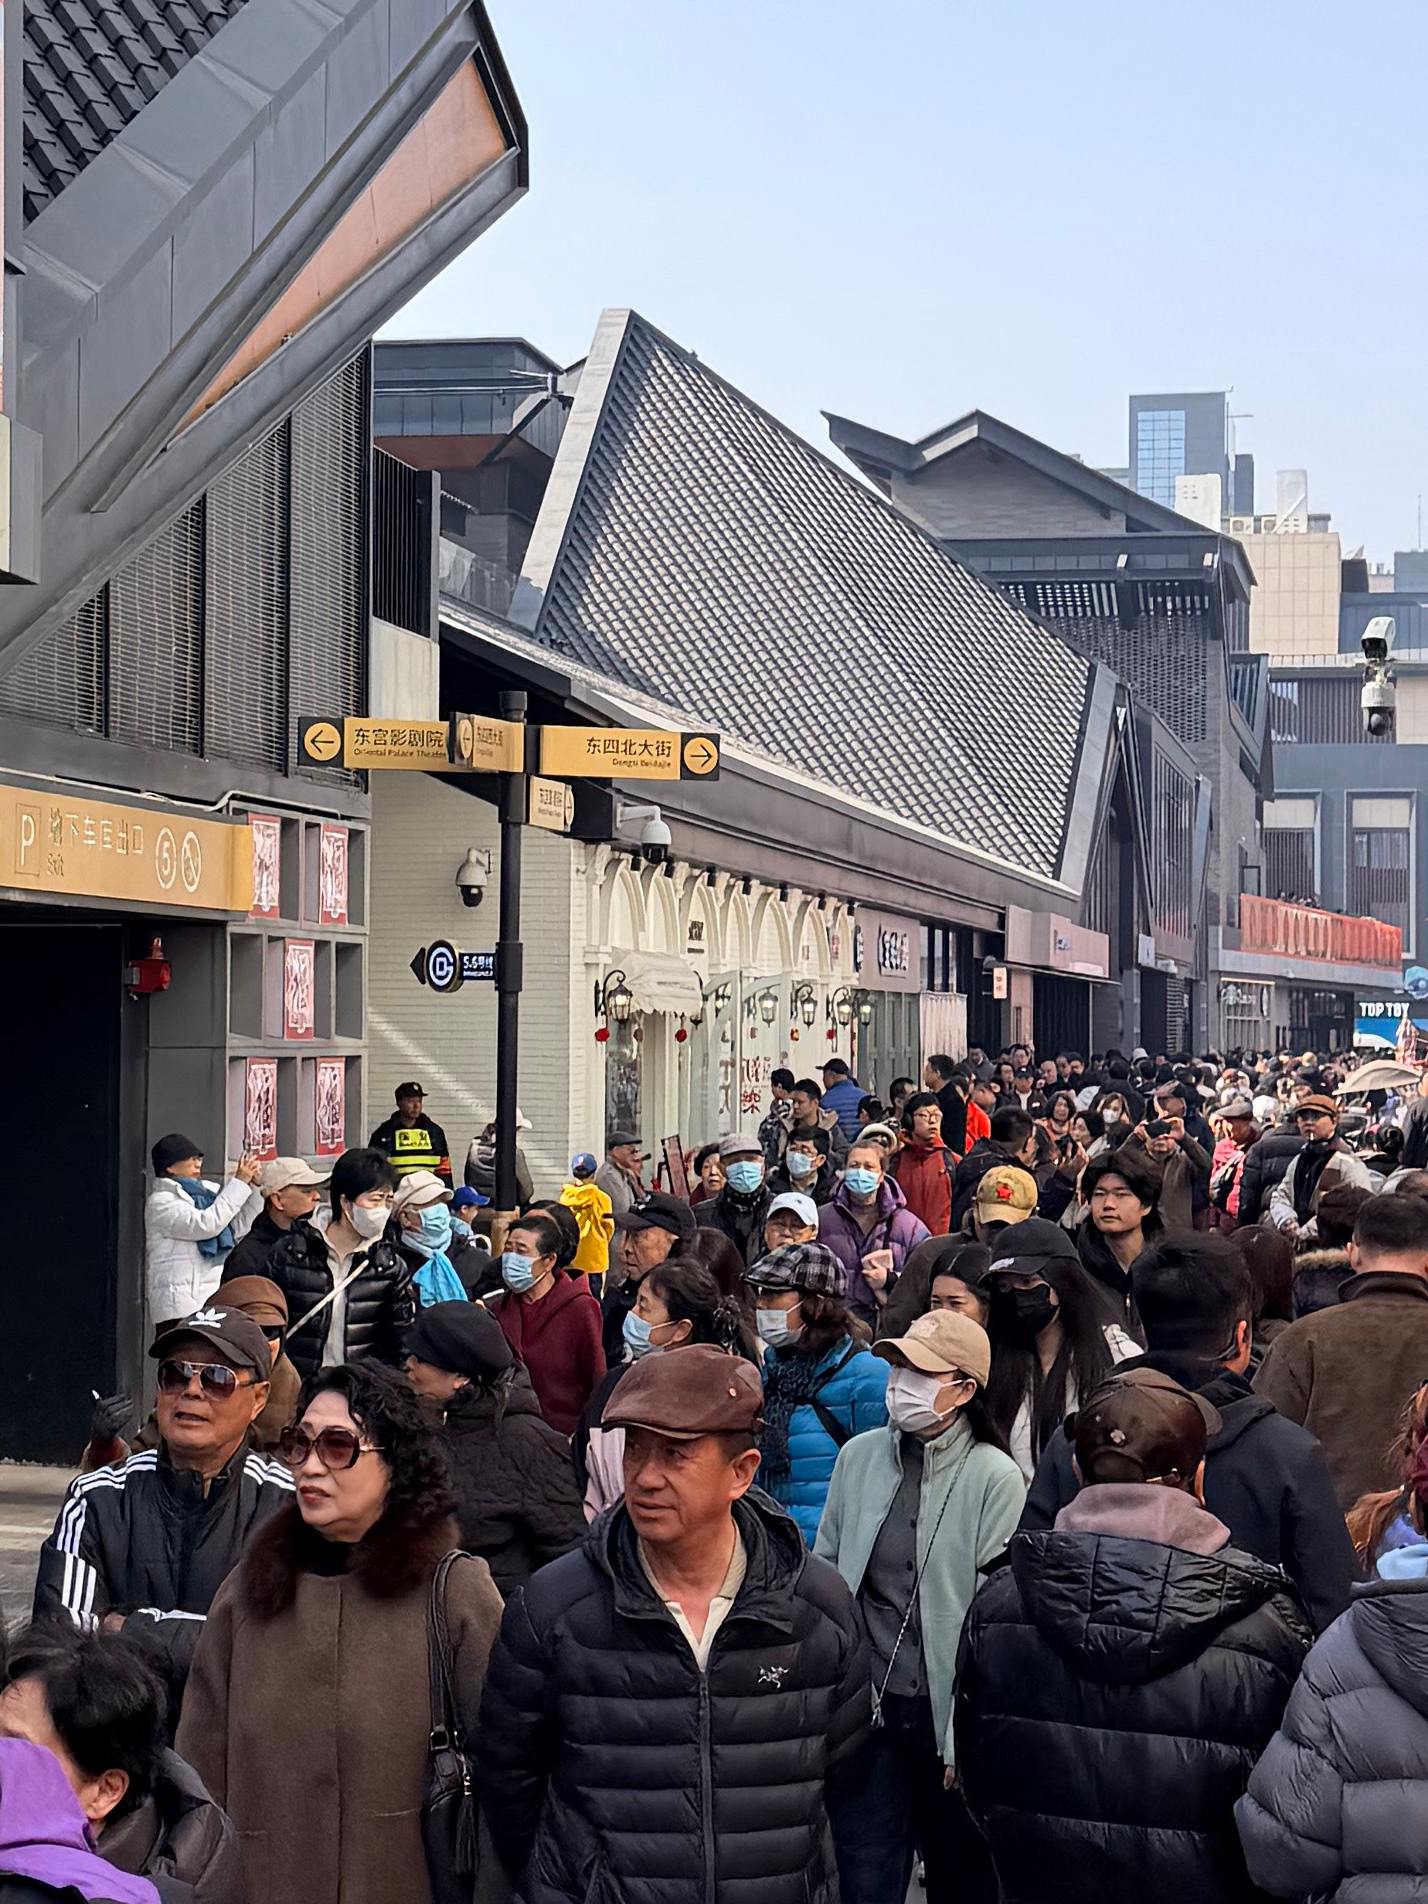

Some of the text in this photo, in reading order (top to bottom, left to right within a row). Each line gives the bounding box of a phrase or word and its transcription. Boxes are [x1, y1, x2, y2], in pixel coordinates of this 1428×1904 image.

[354, 728, 444, 749] 东宫影剧院
[586, 737, 672, 758] 东四北大街
[21, 813, 36, 867] P
[1359, 1001, 1410, 1019] TOP TOY
